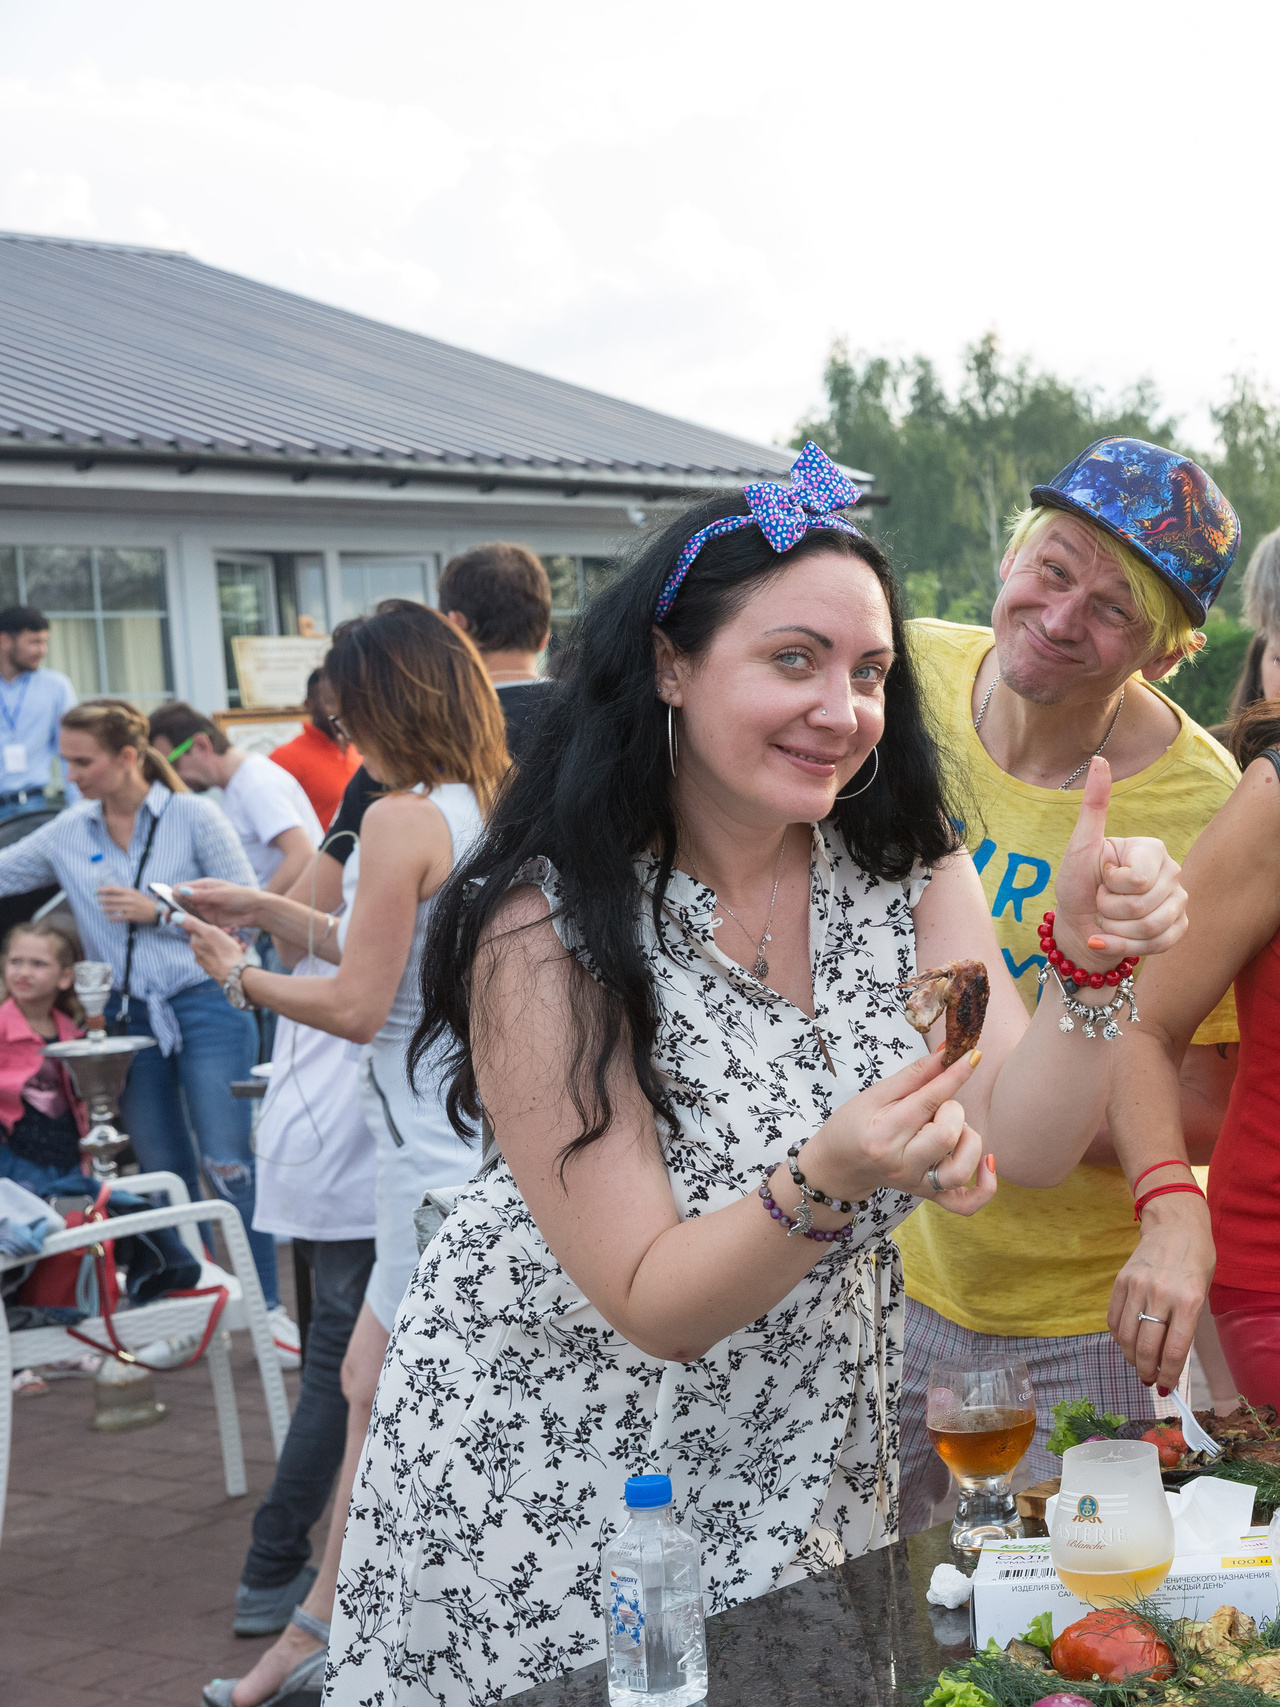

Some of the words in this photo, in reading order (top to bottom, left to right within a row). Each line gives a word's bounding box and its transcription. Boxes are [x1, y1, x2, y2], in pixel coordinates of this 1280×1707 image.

[1066, 1539, 1106, 1550] Blanche
[1218, 1572, 1272, 1581] НАЗНАЧЕНИЯ:
[1202, 1582, 1226, 1590] ДЕНЬ"
